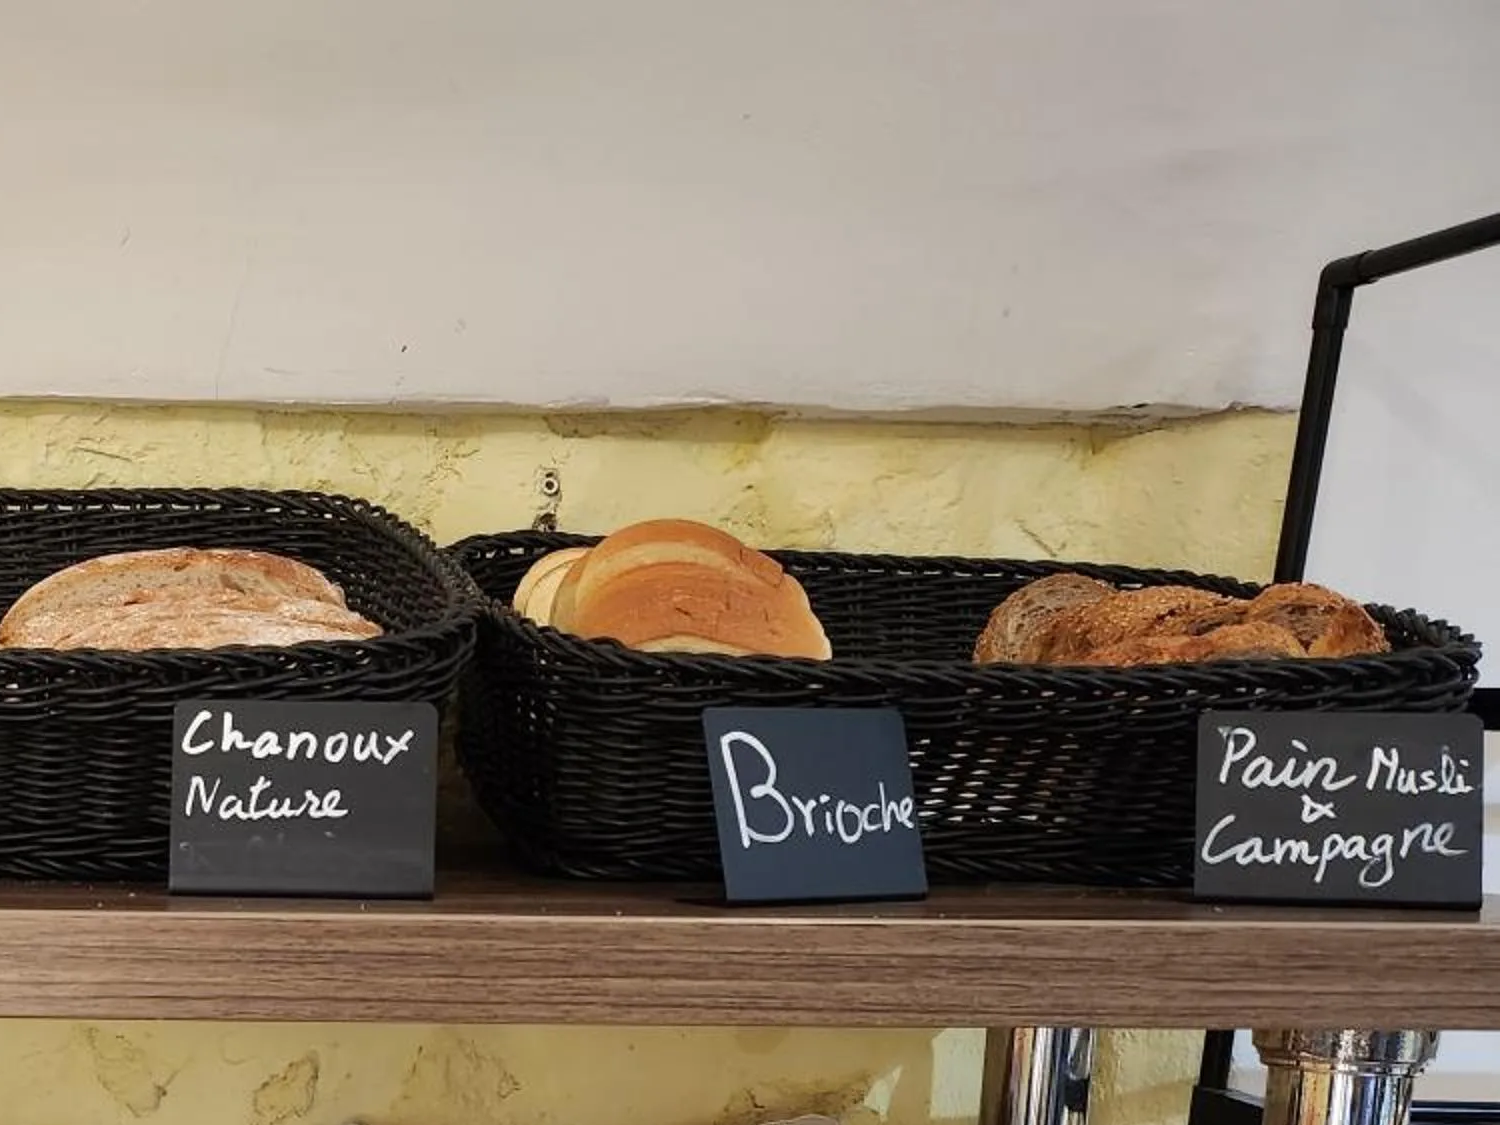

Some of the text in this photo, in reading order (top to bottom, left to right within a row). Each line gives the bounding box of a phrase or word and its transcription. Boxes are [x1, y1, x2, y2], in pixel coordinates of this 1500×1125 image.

[181, 709, 414, 765] Chanoux
[1218, 727, 1477, 795] Pain Musli
[185, 775, 349, 820] Nature
[720, 730, 915, 848] Brioche
[1202, 814, 1468, 887] Campagne
